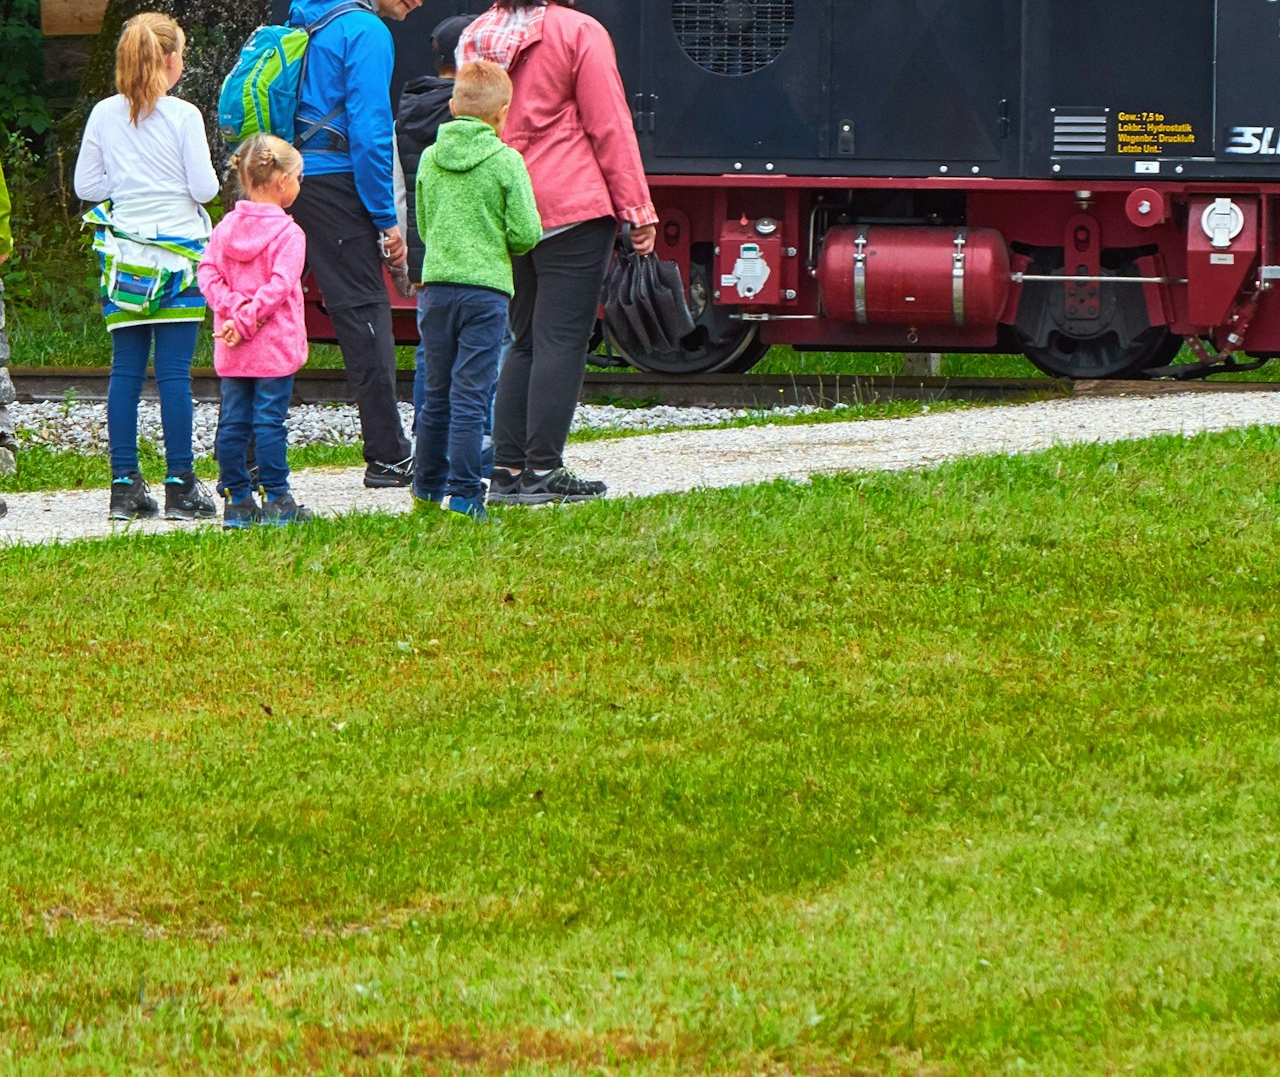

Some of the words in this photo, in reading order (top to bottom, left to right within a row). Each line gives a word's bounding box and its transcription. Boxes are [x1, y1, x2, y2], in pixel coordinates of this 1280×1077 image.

[1118, 112, 1141, 121] Gew.:
[1142, 112, 1154, 122] 7,5
[1155, 113, 1165, 121] to
[1147, 123, 1192, 133] Hydrostatik
[1158, 134, 1195, 143] Druckluft
